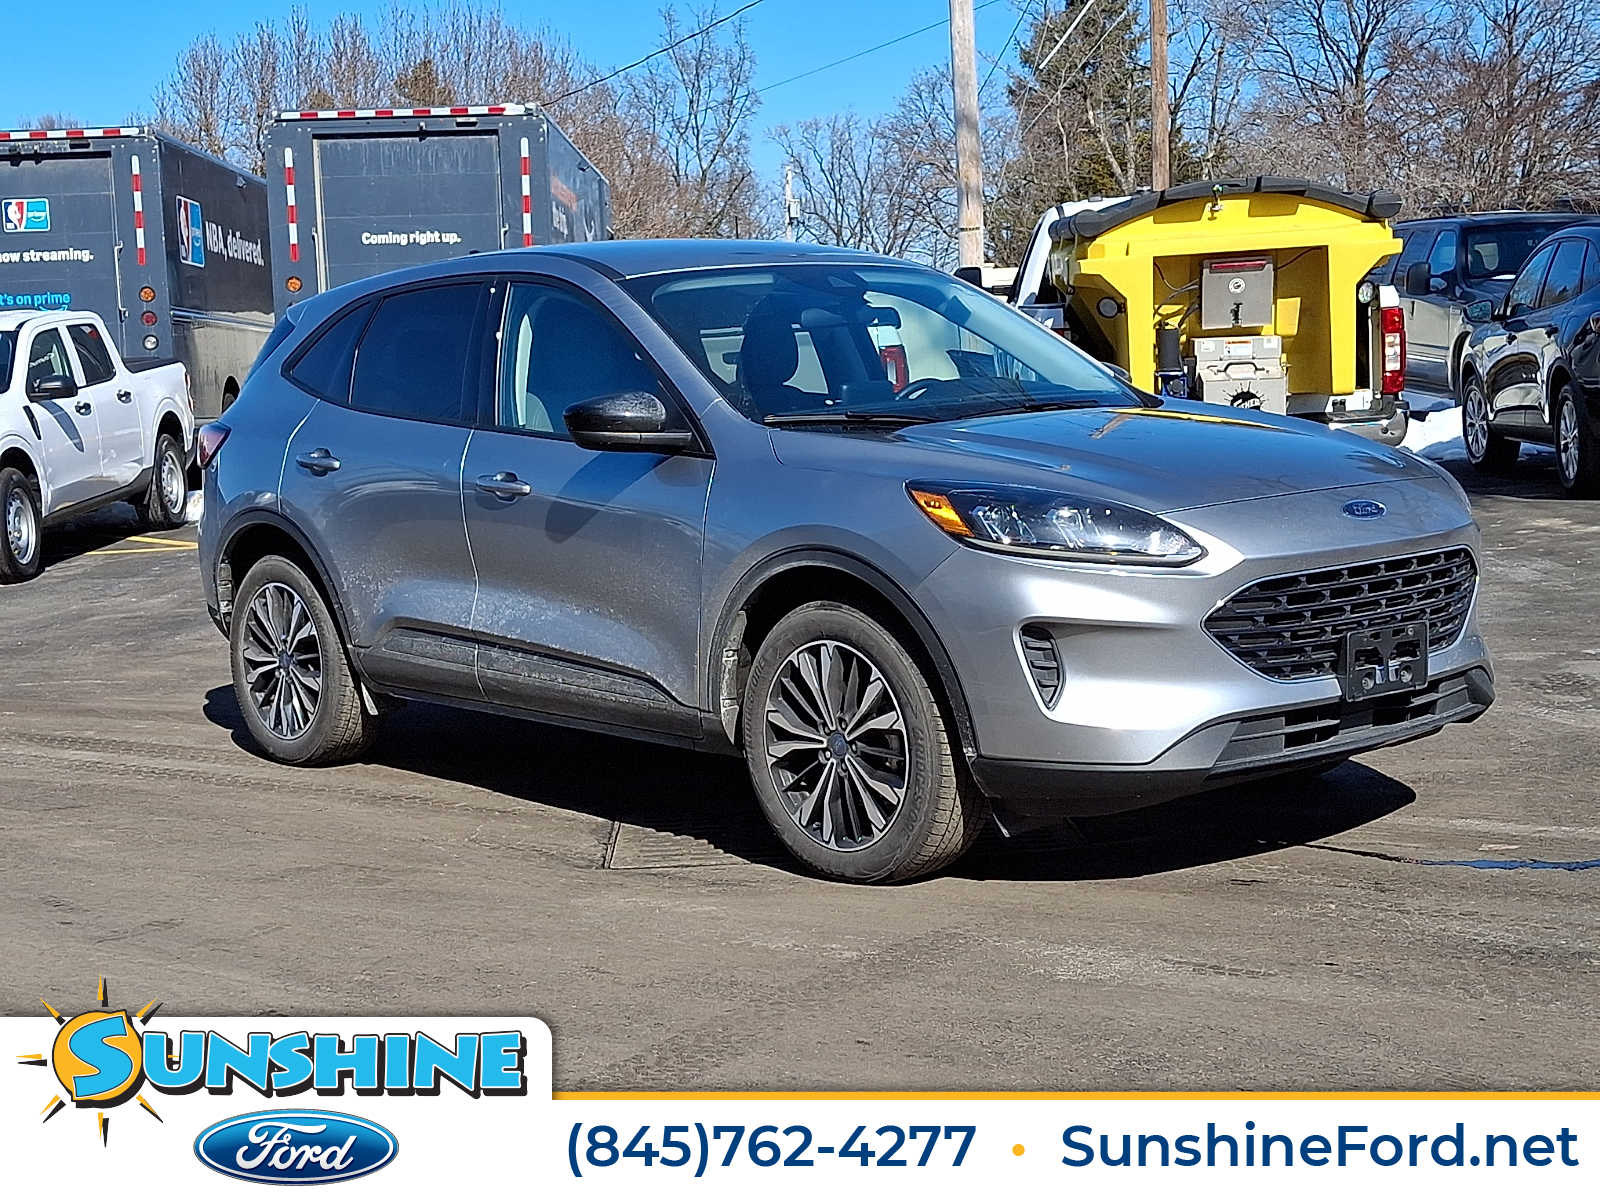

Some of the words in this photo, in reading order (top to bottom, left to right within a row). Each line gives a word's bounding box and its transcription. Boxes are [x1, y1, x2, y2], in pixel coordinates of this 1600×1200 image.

[205, 221, 227, 262] NBA,
[227, 229, 264, 266] delivered.
[362, 232, 408, 245] Coming
[409, 231, 440, 245] right
[442, 233, 461, 244] up.
[0, 252, 20, 263] ow
[23, 248, 94, 262] streaming.
[16, 295, 32, 305] on
[34, 292, 71, 306] prime
